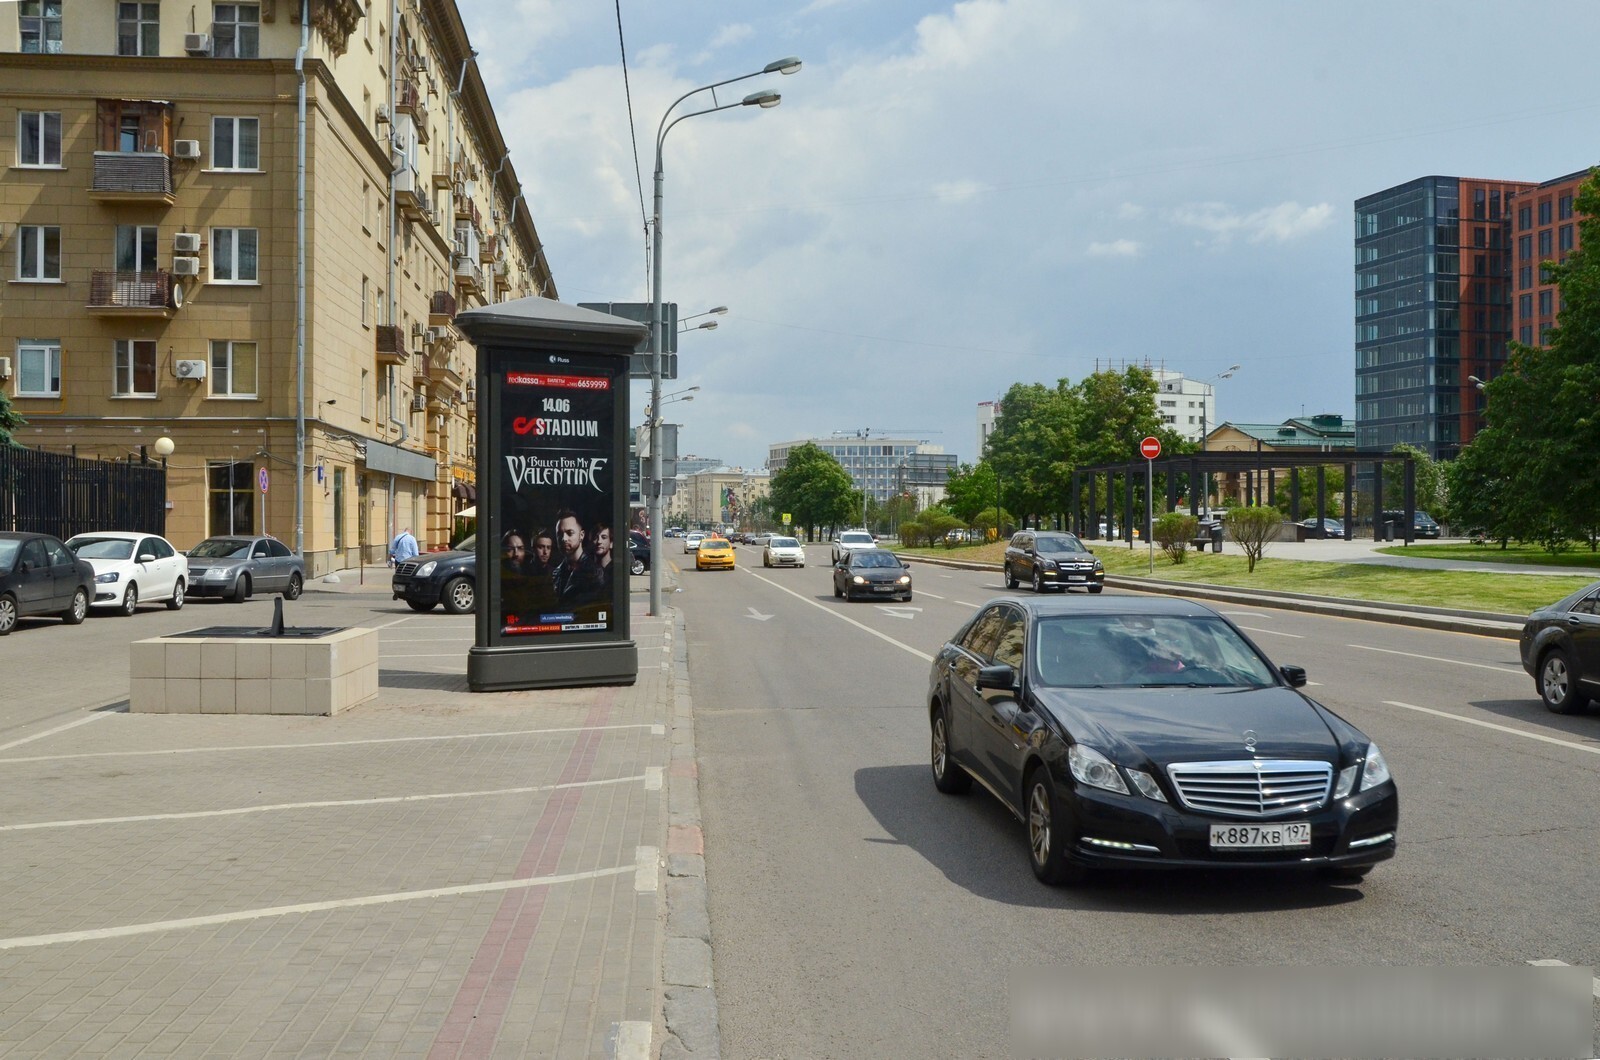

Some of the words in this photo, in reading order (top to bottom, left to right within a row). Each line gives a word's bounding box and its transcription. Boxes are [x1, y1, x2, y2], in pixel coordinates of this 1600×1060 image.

[577, 380, 607, 389] 6659999
[542, 398, 570, 413] 14.06
[535, 418, 598, 437] STADIUM
[527, 455, 559, 467] BULLET
[560, 457, 576, 467] FOR
[577, 457, 589, 468] MY
[505, 455, 608, 493] VALENTINE
[1285, 824, 1307, 838] 197
